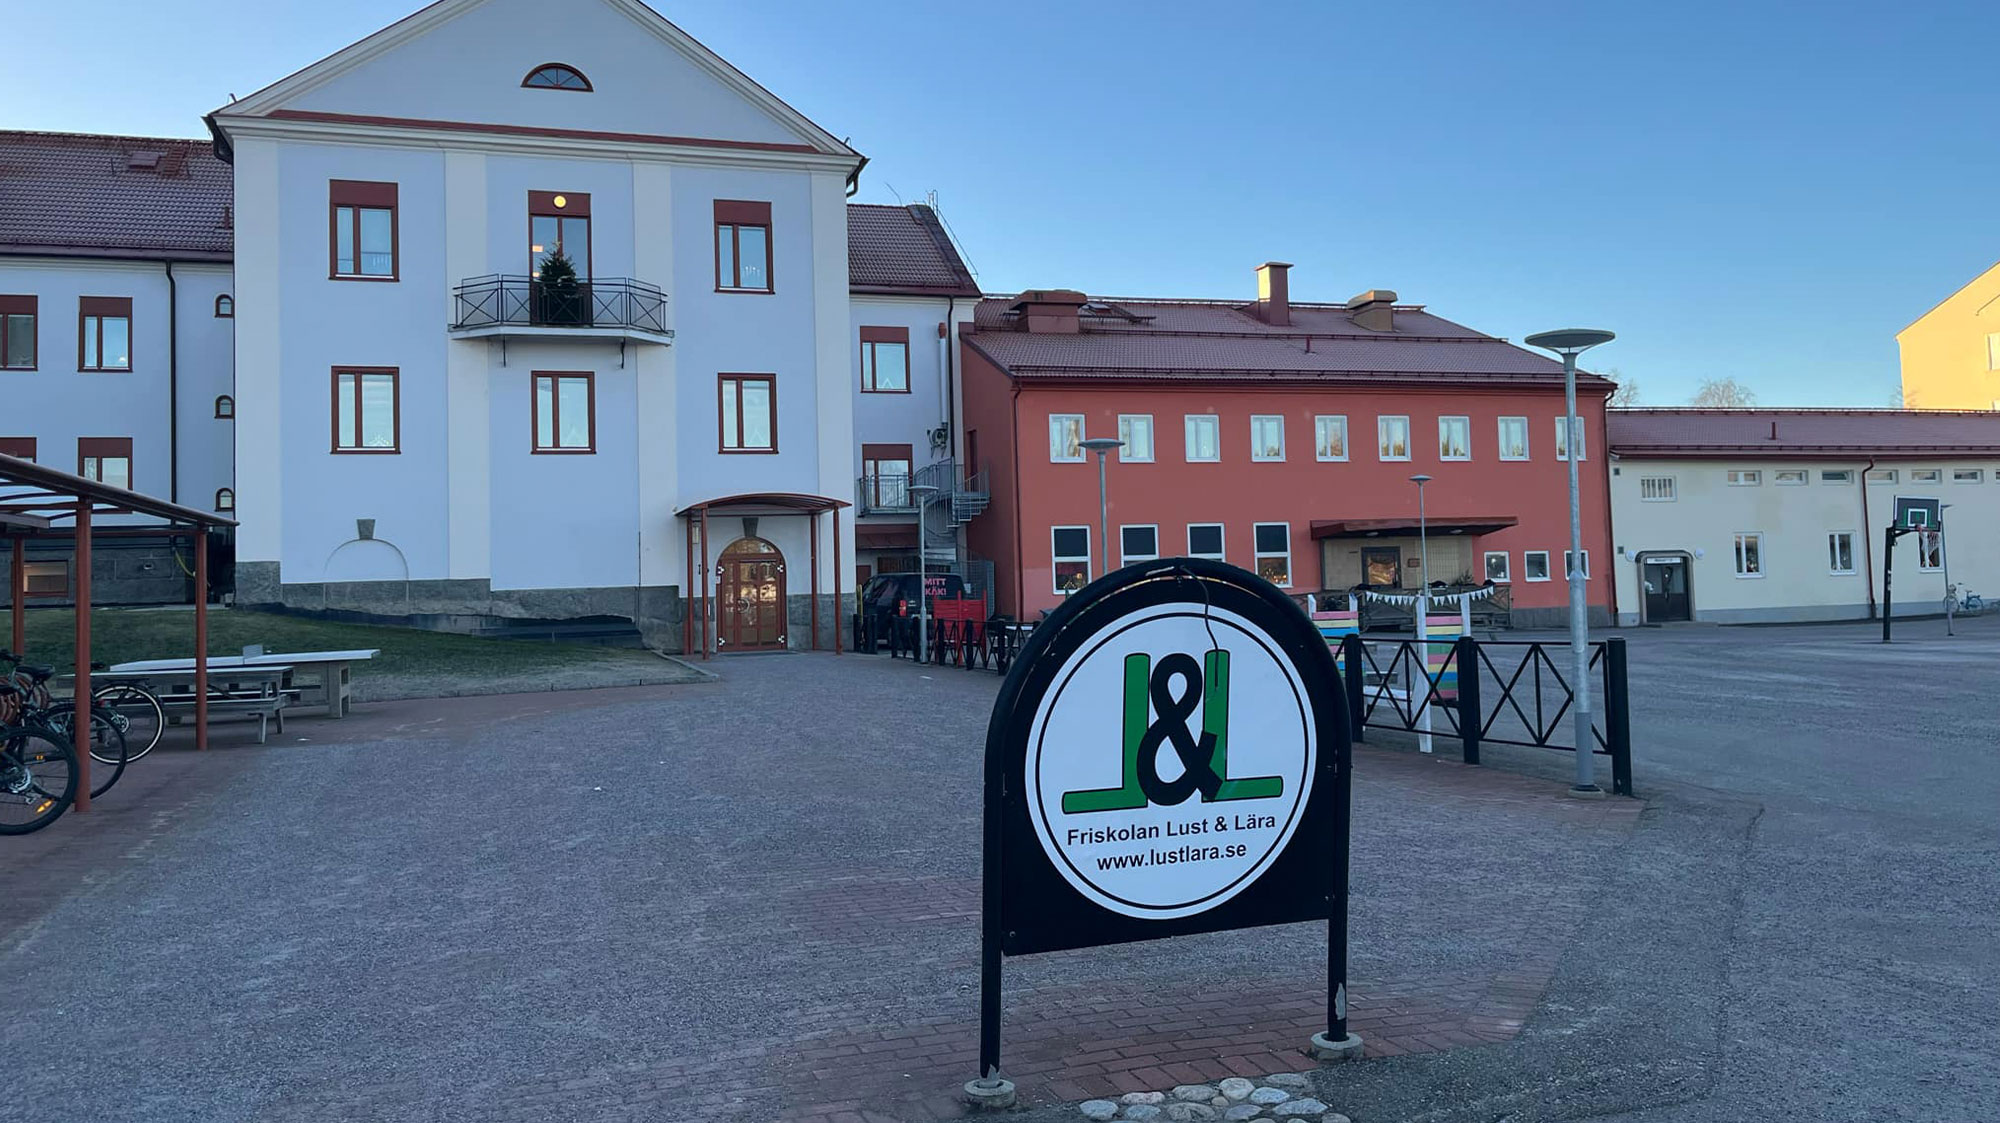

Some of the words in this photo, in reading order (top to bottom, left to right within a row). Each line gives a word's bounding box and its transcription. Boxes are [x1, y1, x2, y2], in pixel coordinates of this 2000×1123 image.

[924, 578, 946, 586] MITT
[1067, 824, 1160, 846] Friskolan
[1166, 818, 1209, 837] Lust
[1214, 815, 1228, 832] &
[1234, 813, 1276, 831] Lära
[1096, 843, 1247, 871] www.lustlara.se
